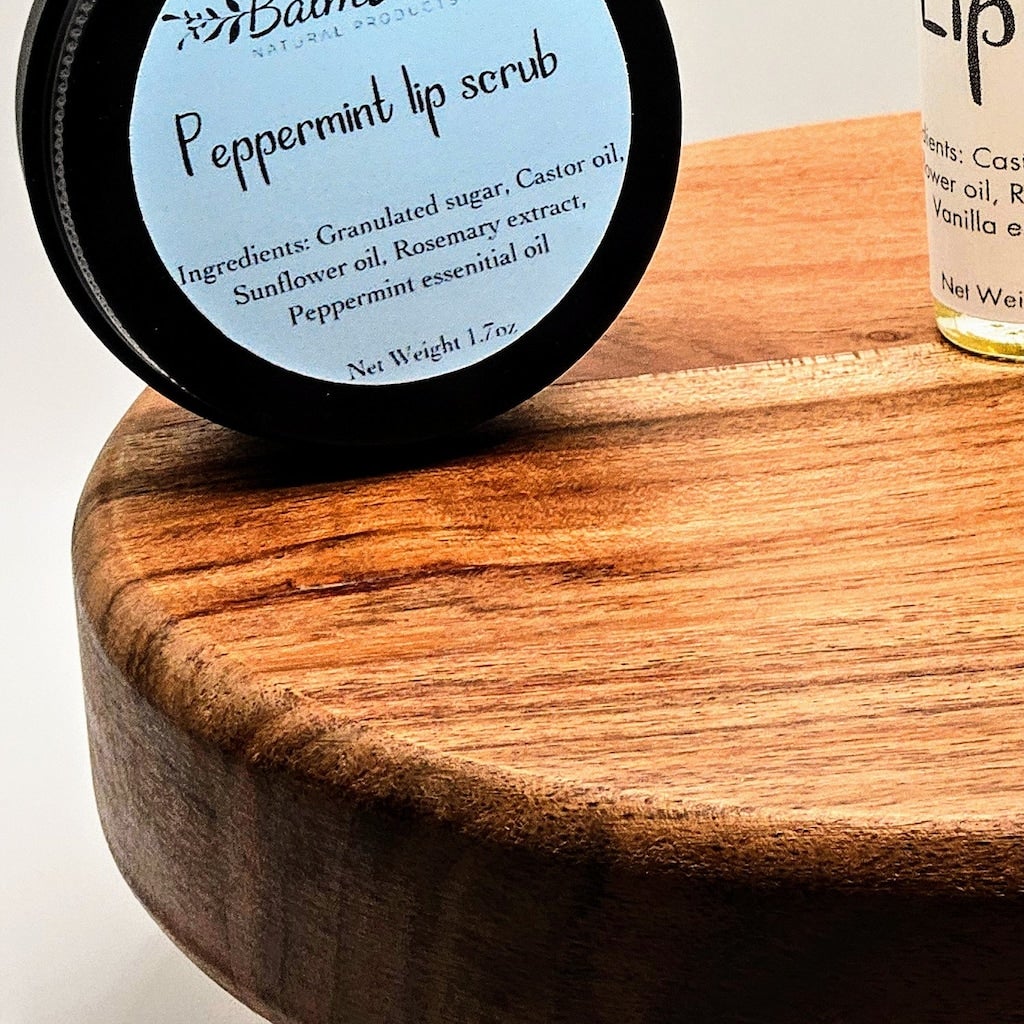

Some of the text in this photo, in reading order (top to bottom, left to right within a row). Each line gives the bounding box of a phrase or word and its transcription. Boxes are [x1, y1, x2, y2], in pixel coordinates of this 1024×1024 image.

[251, 26, 343, 58] NATURAL
[174, 27, 559, 192] Peppermint lip scrub
[177, 142, 625, 286] Ingredients: Granulated sugar, Castor oil,
[933, 195, 997, 236] Vanilla
[963, 178, 999, 206] oil,
[232, 193, 587, 306] Sunflower oil, Rosemary extract,
[288, 232, 551, 327] Peppermint essenitial oil
[941, 271, 970, 302] Net
[346, 320, 519, 382] Net Weight 1.7oz
